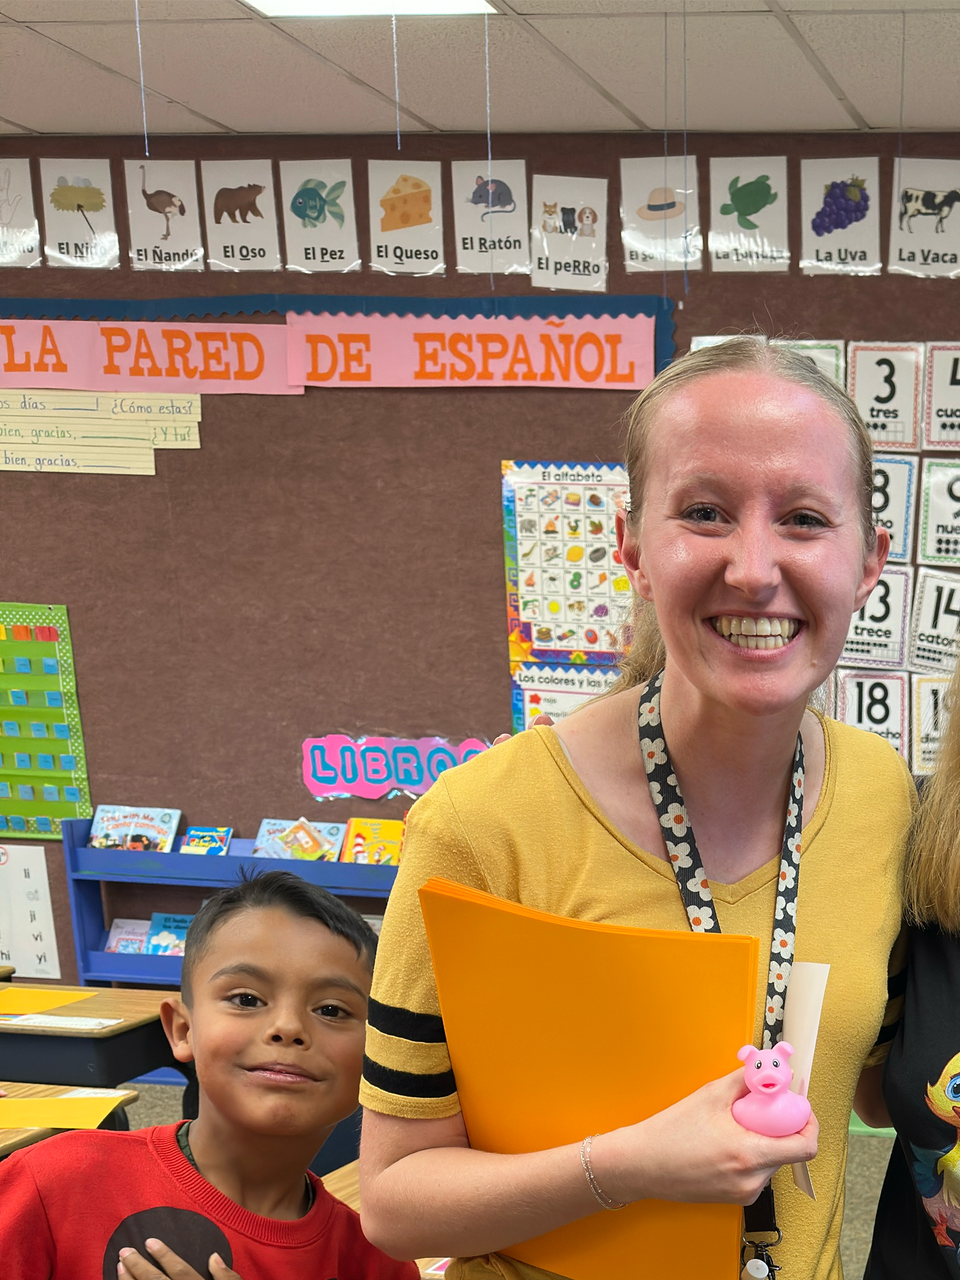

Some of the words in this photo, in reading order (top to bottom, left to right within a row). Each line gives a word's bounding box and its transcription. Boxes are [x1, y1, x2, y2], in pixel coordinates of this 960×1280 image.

[58, 242, 70, 255] El
[462, 237, 474, 250] El
[478, 235, 522, 253] Ratón
[136, 248, 148, 261] El
[223, 245, 235, 259] El
[239, 245, 266, 260] Oso
[304, 248, 316, 260] El
[320, 248, 345, 262] Pez
[376, 245, 388, 259] El
[393, 246, 439, 265] Queso
[816, 249, 833, 262] La
[837, 248, 867, 264] Uva
[898, 248, 916, 262] La
[920, 248, 958, 265] Vaca
[537, 257, 549, 271] El
[554, 259, 600, 278] peRRo
[0, 325, 68, 373] LA
[100, 326, 265, 381] PARED
[305, 334, 372, 382] DE
[413, 320, 635, 384] ESPAÑOL
[874, 357, 896, 404] 3
[21, 394, 46, 410] días
[870, 406, 898, 419] tres
[542, 472, 551, 481] El
[554, 471, 603, 482] alfabeto
[854, 625, 892, 639] trece
[518, 673, 535, 683] Los
[538, 674, 576, 686] colores
[576, 679, 584, 688] y
[586, 678, 601, 688] las
[856, 682, 890, 725] 18
